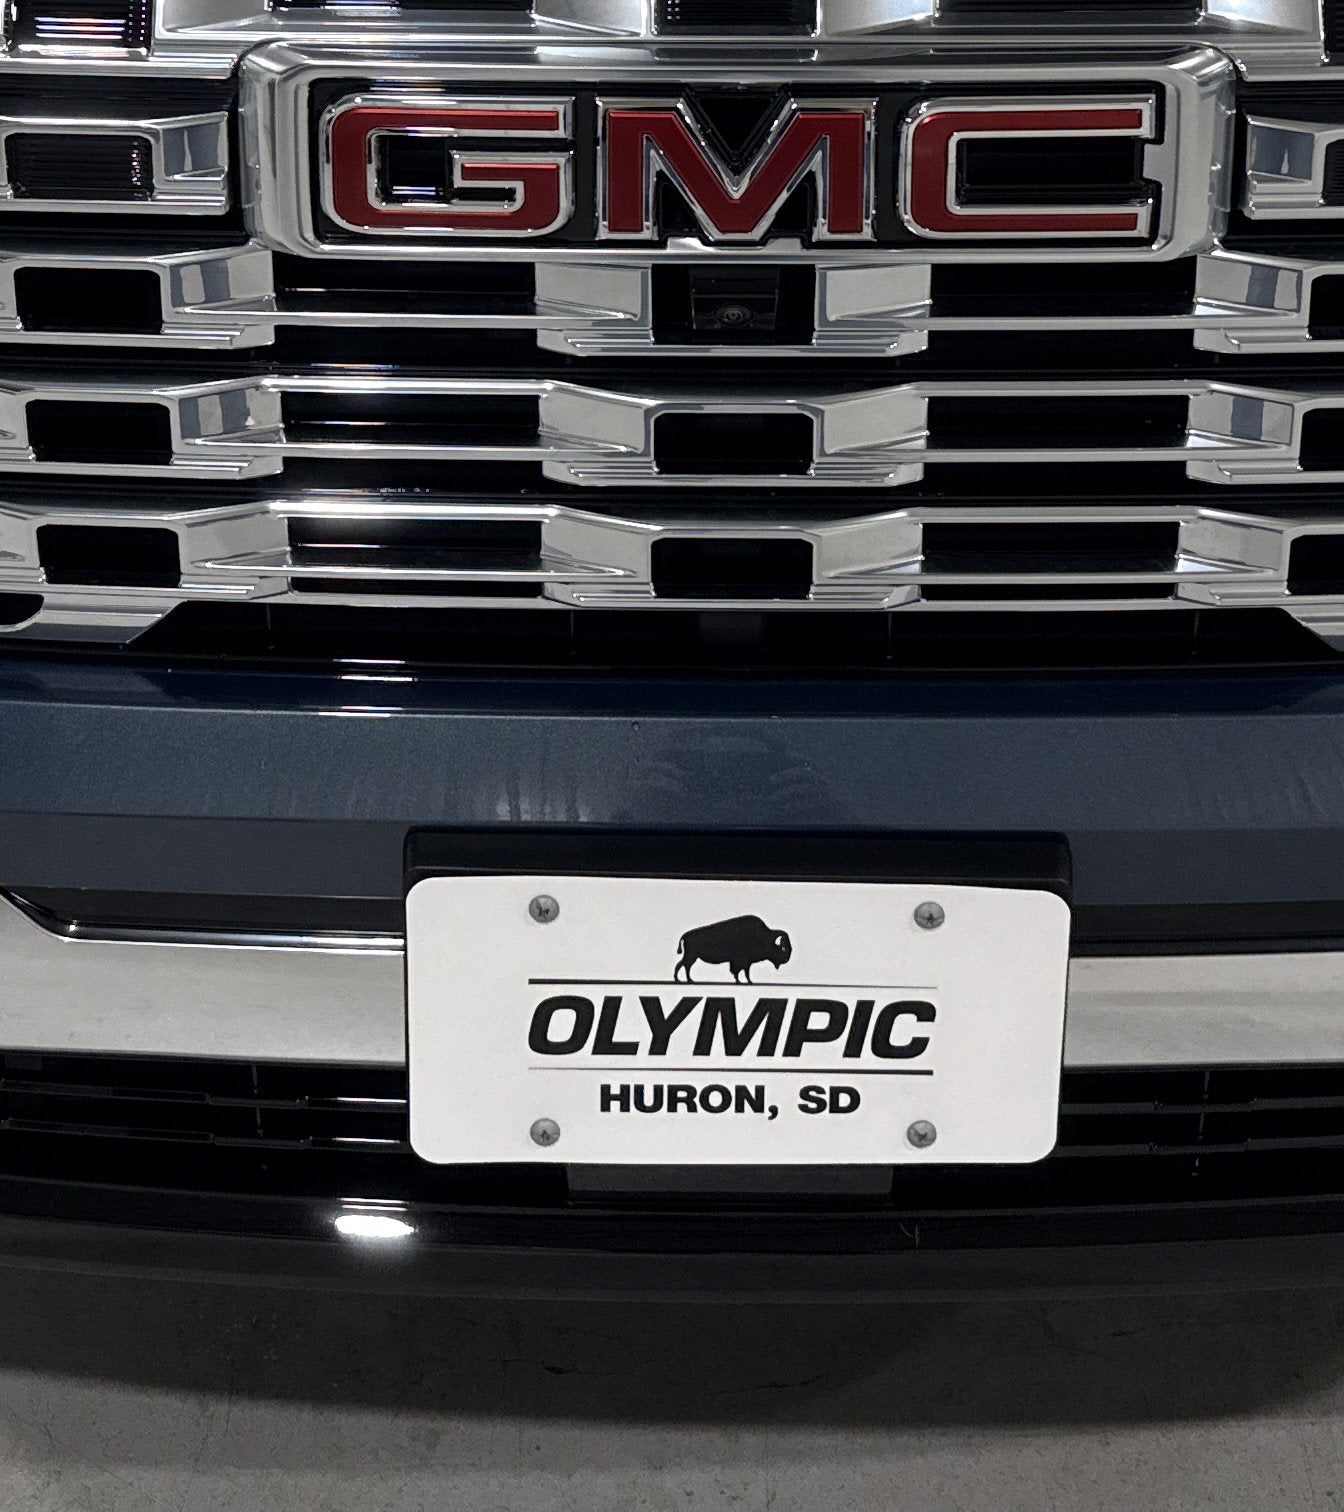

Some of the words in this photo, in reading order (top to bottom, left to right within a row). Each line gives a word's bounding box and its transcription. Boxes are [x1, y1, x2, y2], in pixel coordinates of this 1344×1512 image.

[319, 93, 1156, 241] GMC
[527, 994, 936, 1060] OLYMPIC
[599, 1083, 779, 1120] HURON,
[797, 1085, 862, 1115] SD
